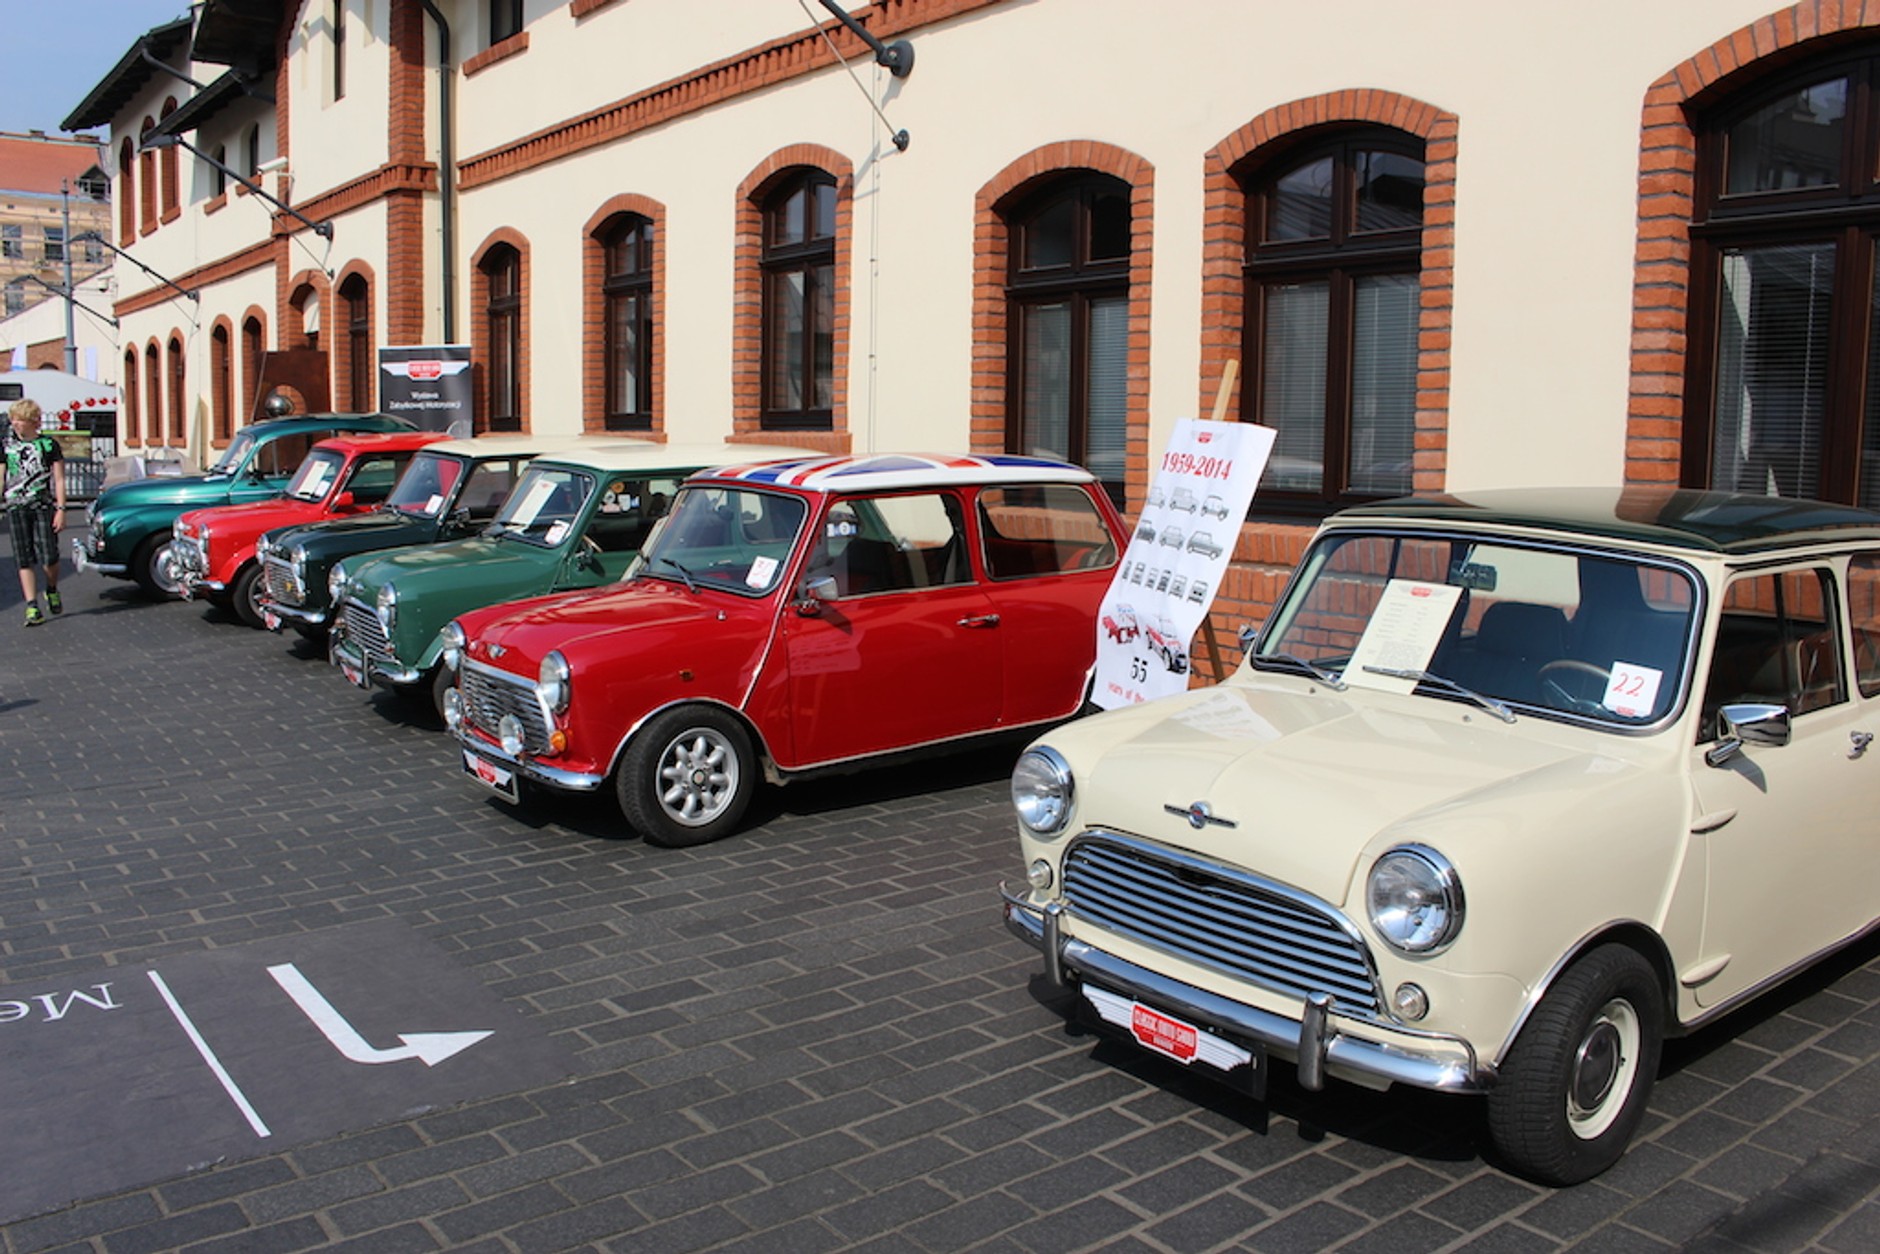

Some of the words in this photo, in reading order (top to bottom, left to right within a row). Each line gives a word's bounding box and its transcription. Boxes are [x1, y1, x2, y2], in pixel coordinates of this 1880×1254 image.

[1162, 452, 1233, 480] 1959-2014
[1131, 657, 1147, 682] 55
[1612, 672, 1645, 697] 22
